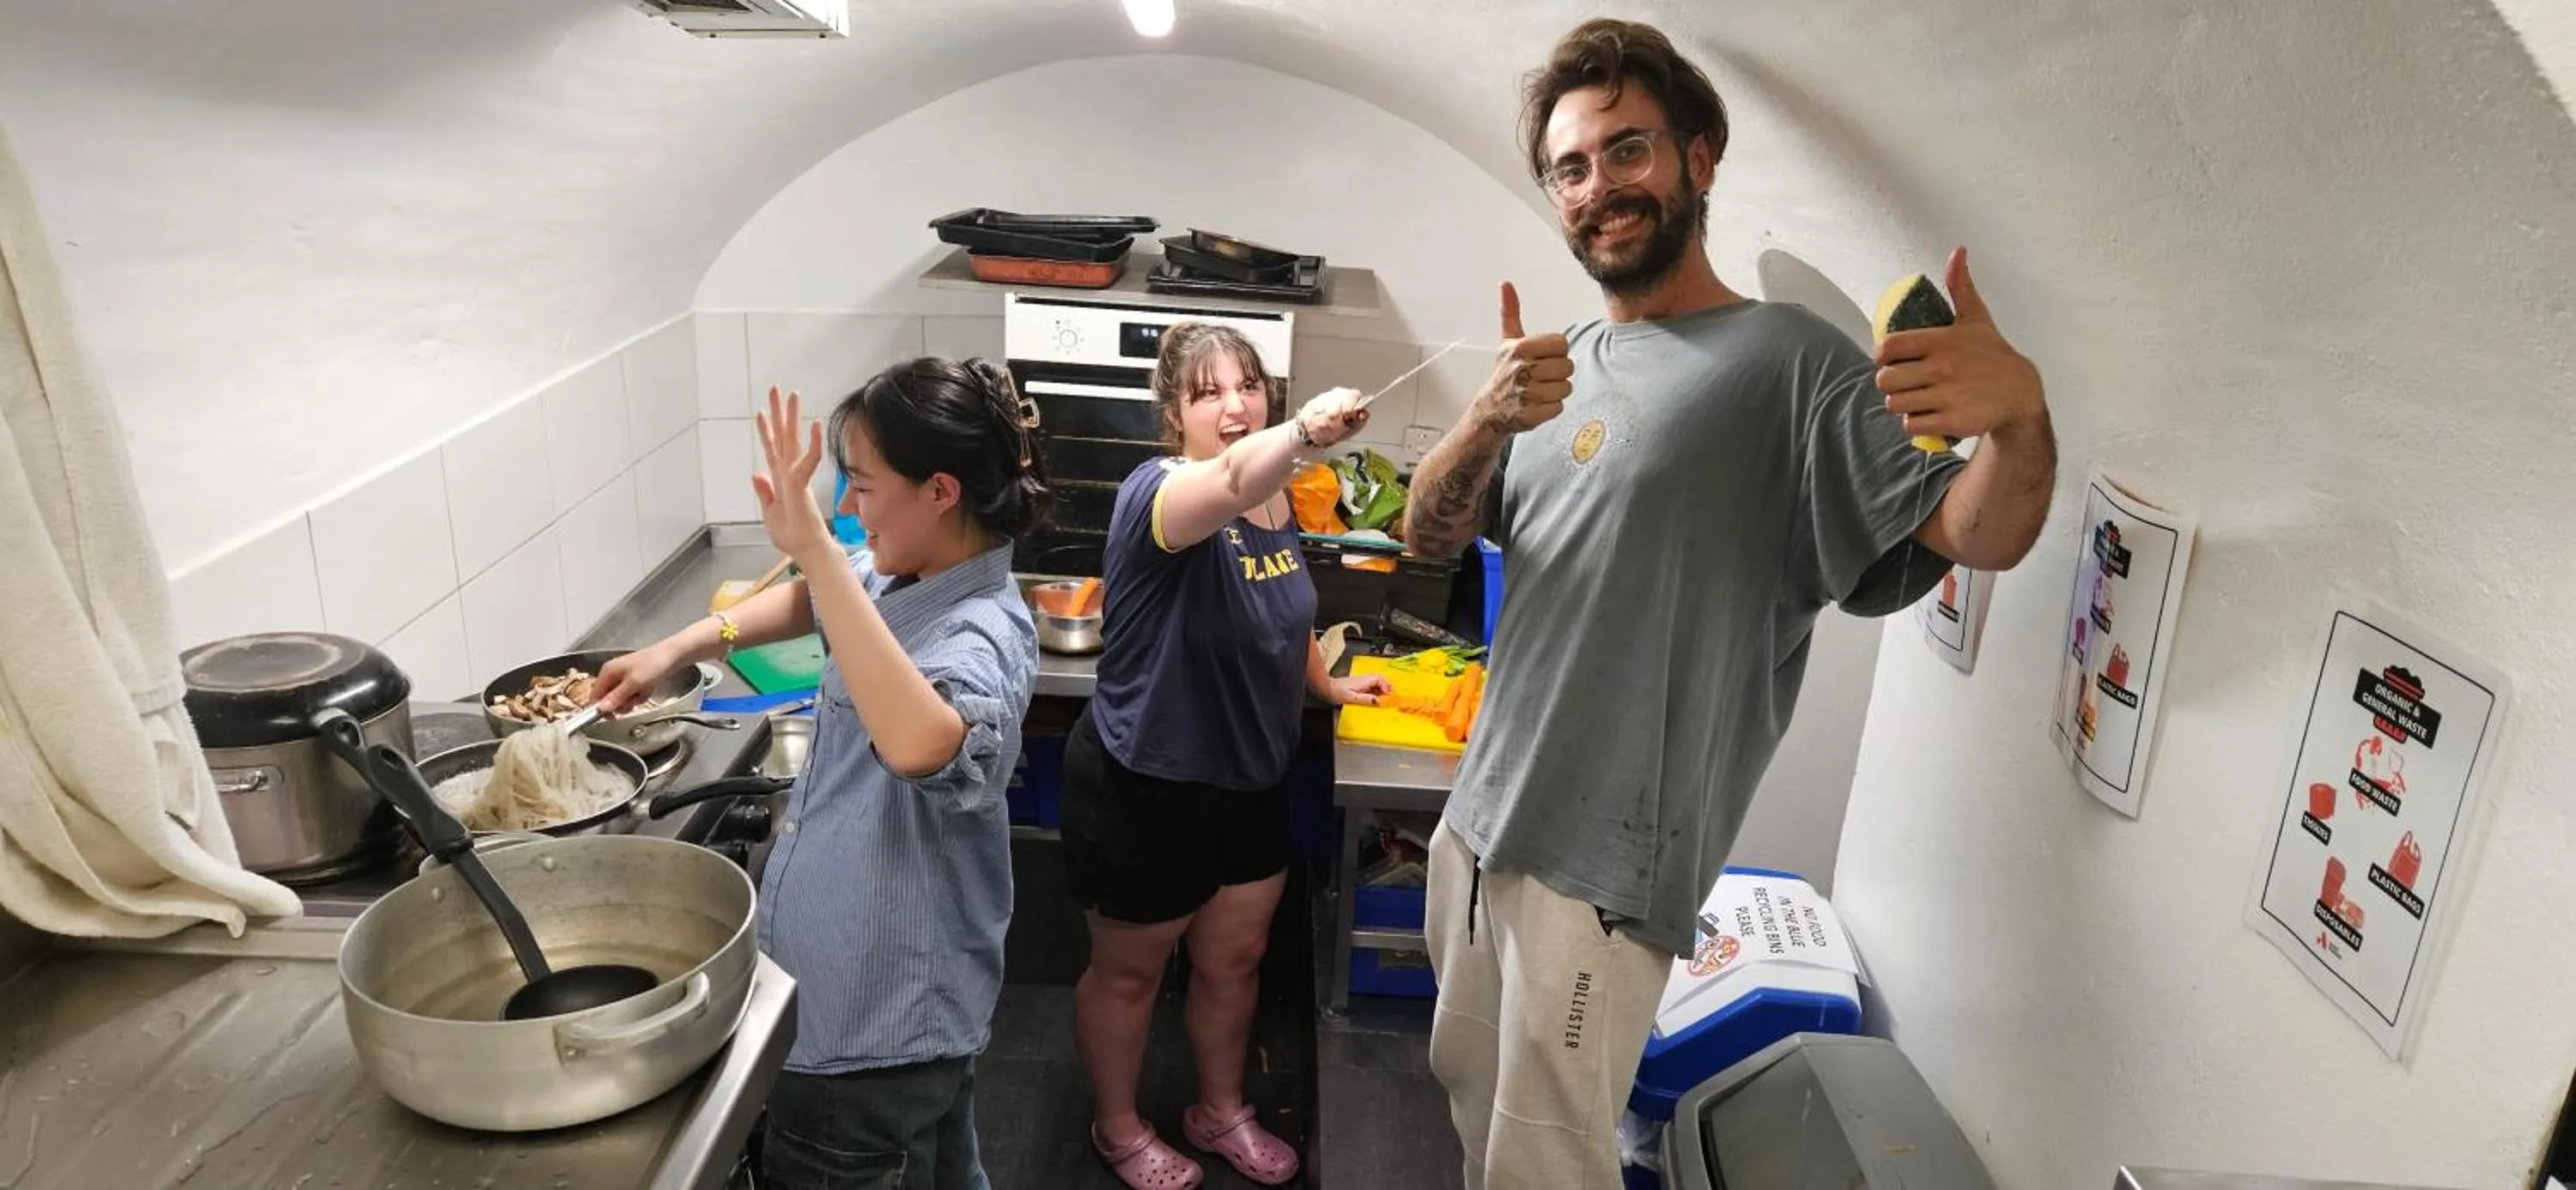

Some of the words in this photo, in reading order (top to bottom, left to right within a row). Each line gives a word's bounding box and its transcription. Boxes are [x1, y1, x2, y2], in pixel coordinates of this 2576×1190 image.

[2361, 692, 2397, 720] GENERAL
[2397, 713, 2428, 740] WASTE
[2374, 683, 2414, 713] ORGANIC
[2413, 706, 2421, 719] &
[2371, 787, 2398, 811] WASTE
[2371, 869, 2403, 899] PLASTIC
[2401, 892, 2423, 914] BAGS
[1735, 906, 1756, 938] PLEASE
[1752, 887, 1777, 932] RECYCLING
[1765, 932, 1784, 954] BINS
[1779, 908, 1798, 925] THE
[1784, 925, 1806, 949] BLUE
[1806, 920, 1826, 948] FOOD
[1565, 972, 1592, 1048] HOLLISTER
